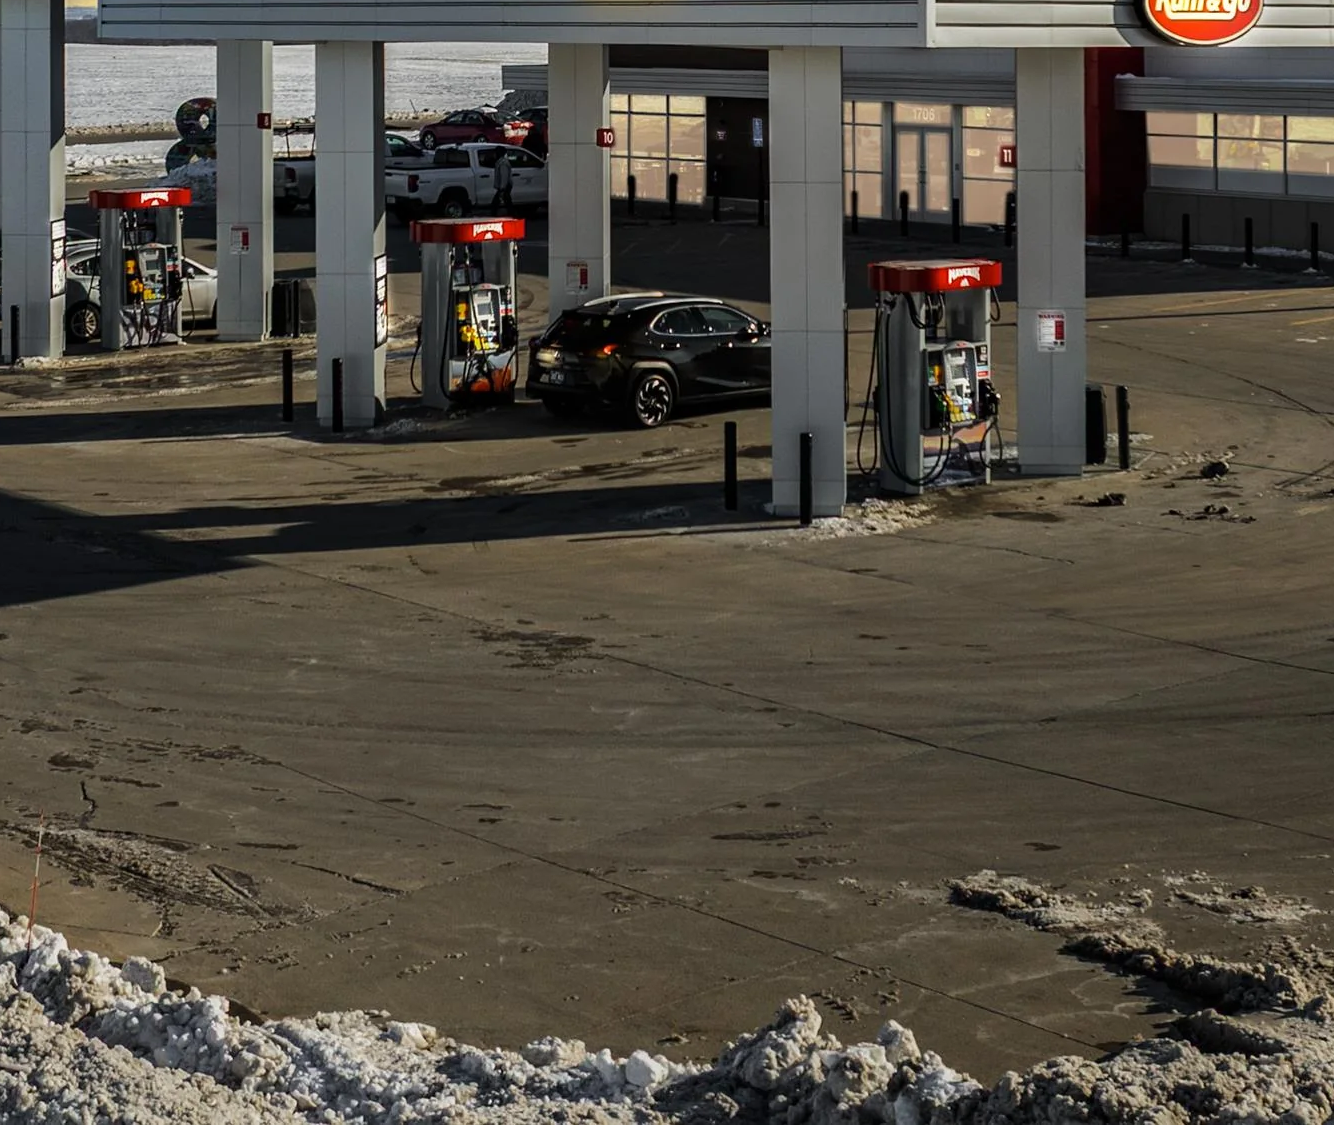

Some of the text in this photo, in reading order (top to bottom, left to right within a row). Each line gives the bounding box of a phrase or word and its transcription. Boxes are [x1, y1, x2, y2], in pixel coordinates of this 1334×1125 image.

[913, 107, 936, 121] 1706
[603, 131, 614, 145] 10
[1002, 149, 1013, 163] 11
